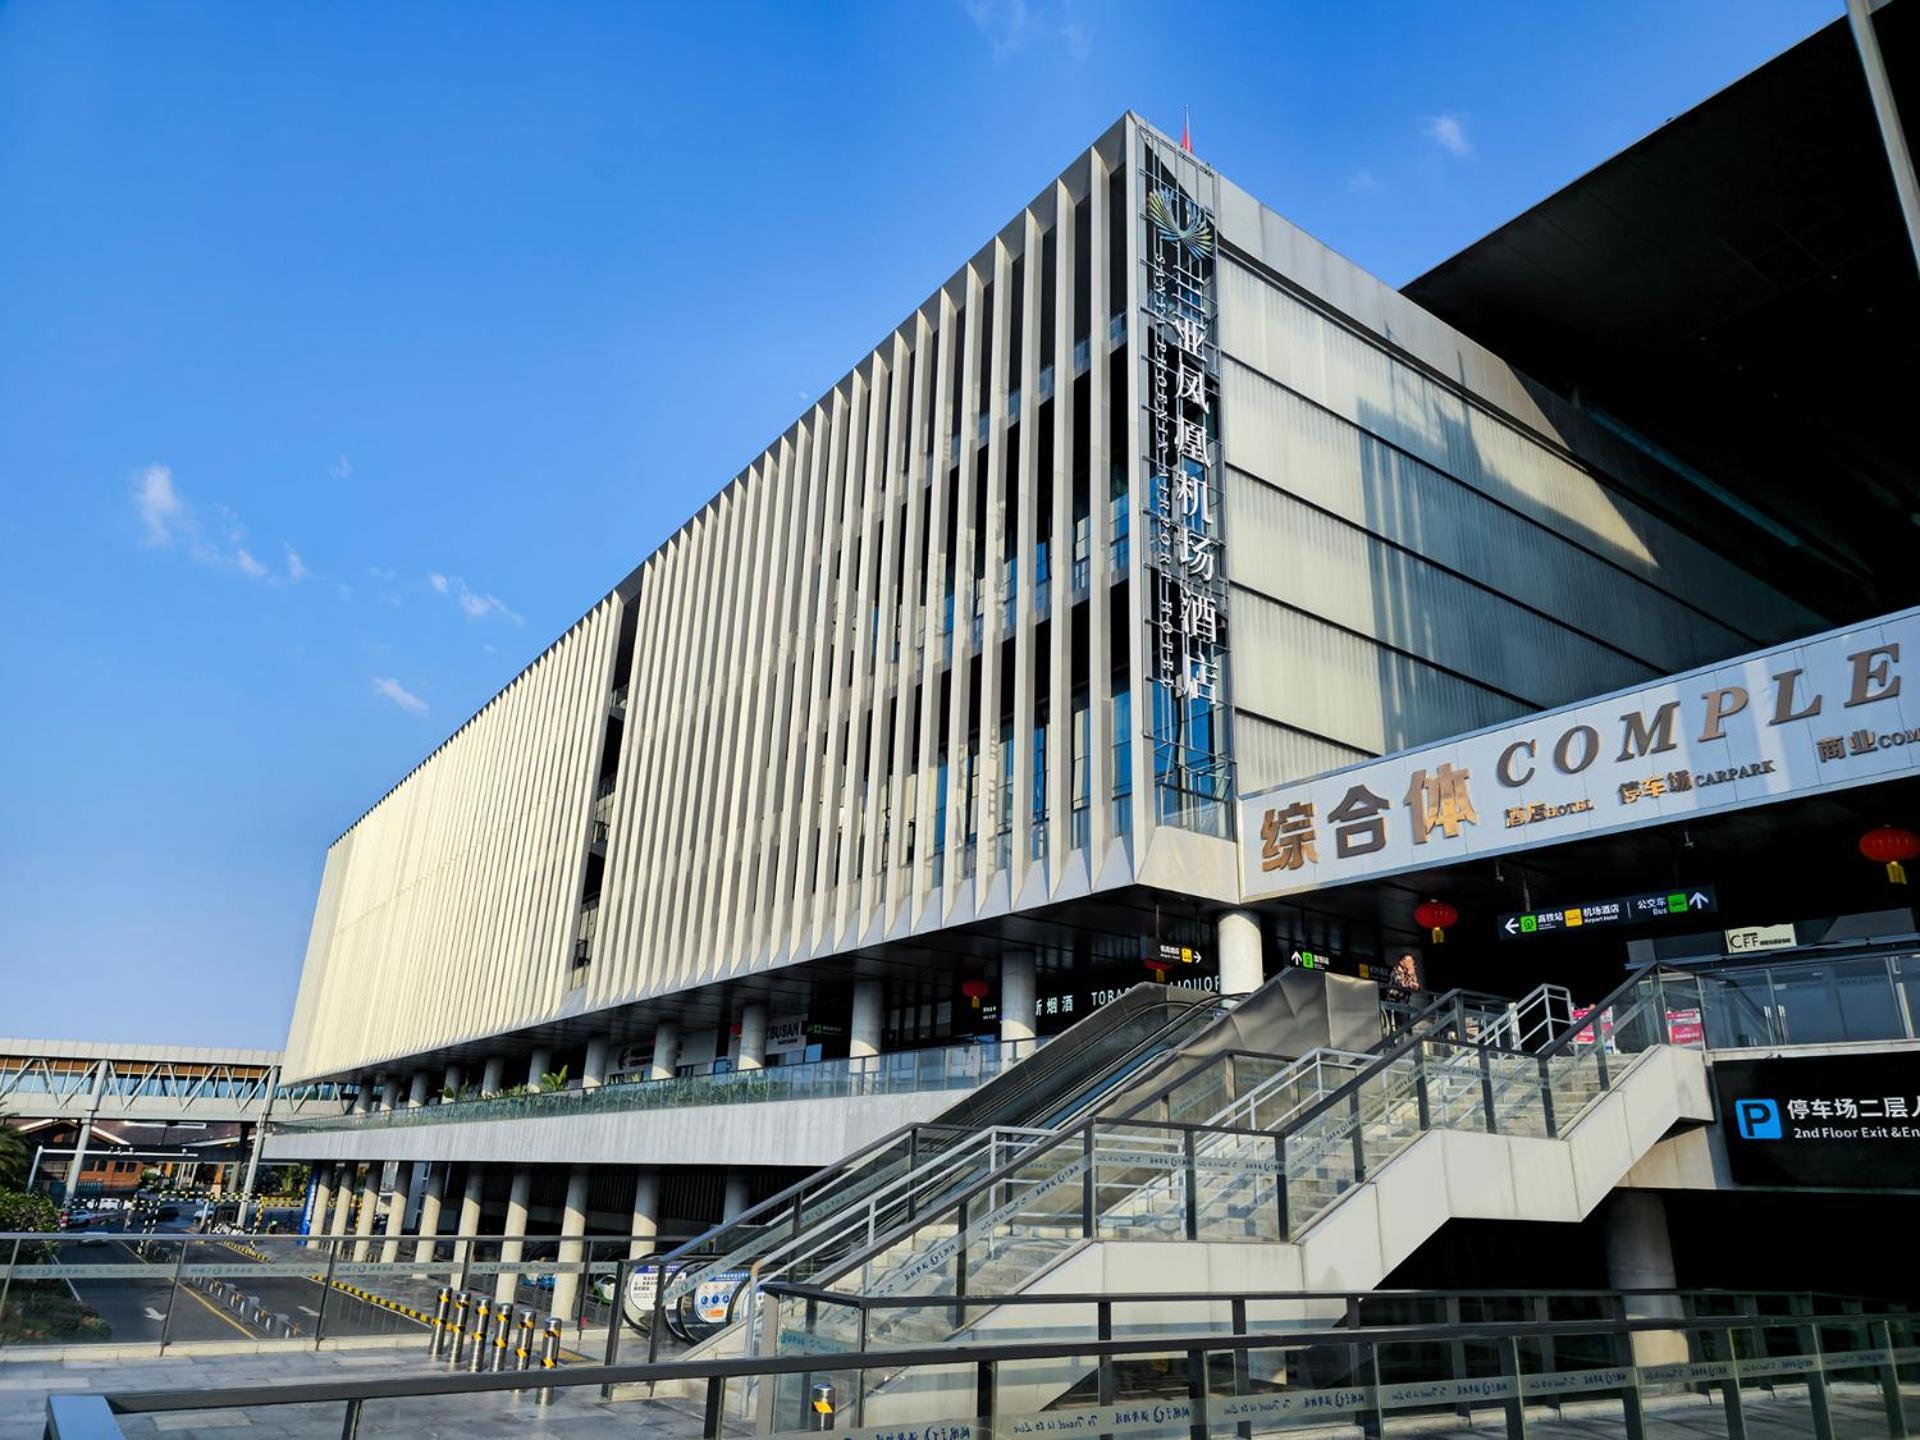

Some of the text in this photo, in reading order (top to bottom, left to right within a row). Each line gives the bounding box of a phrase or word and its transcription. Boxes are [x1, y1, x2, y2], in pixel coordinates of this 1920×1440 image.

[1157, 463, 1171, 583] AIRPORT
[1161, 601, 1174, 688] HOTEL
[1261, 643, 1901, 872] 综合体 COMPLE
[1816, 729, 1878, 763] 商业
[1619, 760, 1776, 804] 停车场 CARPARK
[1505, 799, 1595, 828] 酒店 HOTEL
[1742, 1103, 1772, 1136] P
[1794, 1127, 1820, 1139] 2nd
[1822, 1126, 1858, 1139] Floor
[1861, 1126, 1889, 1138] Exit
